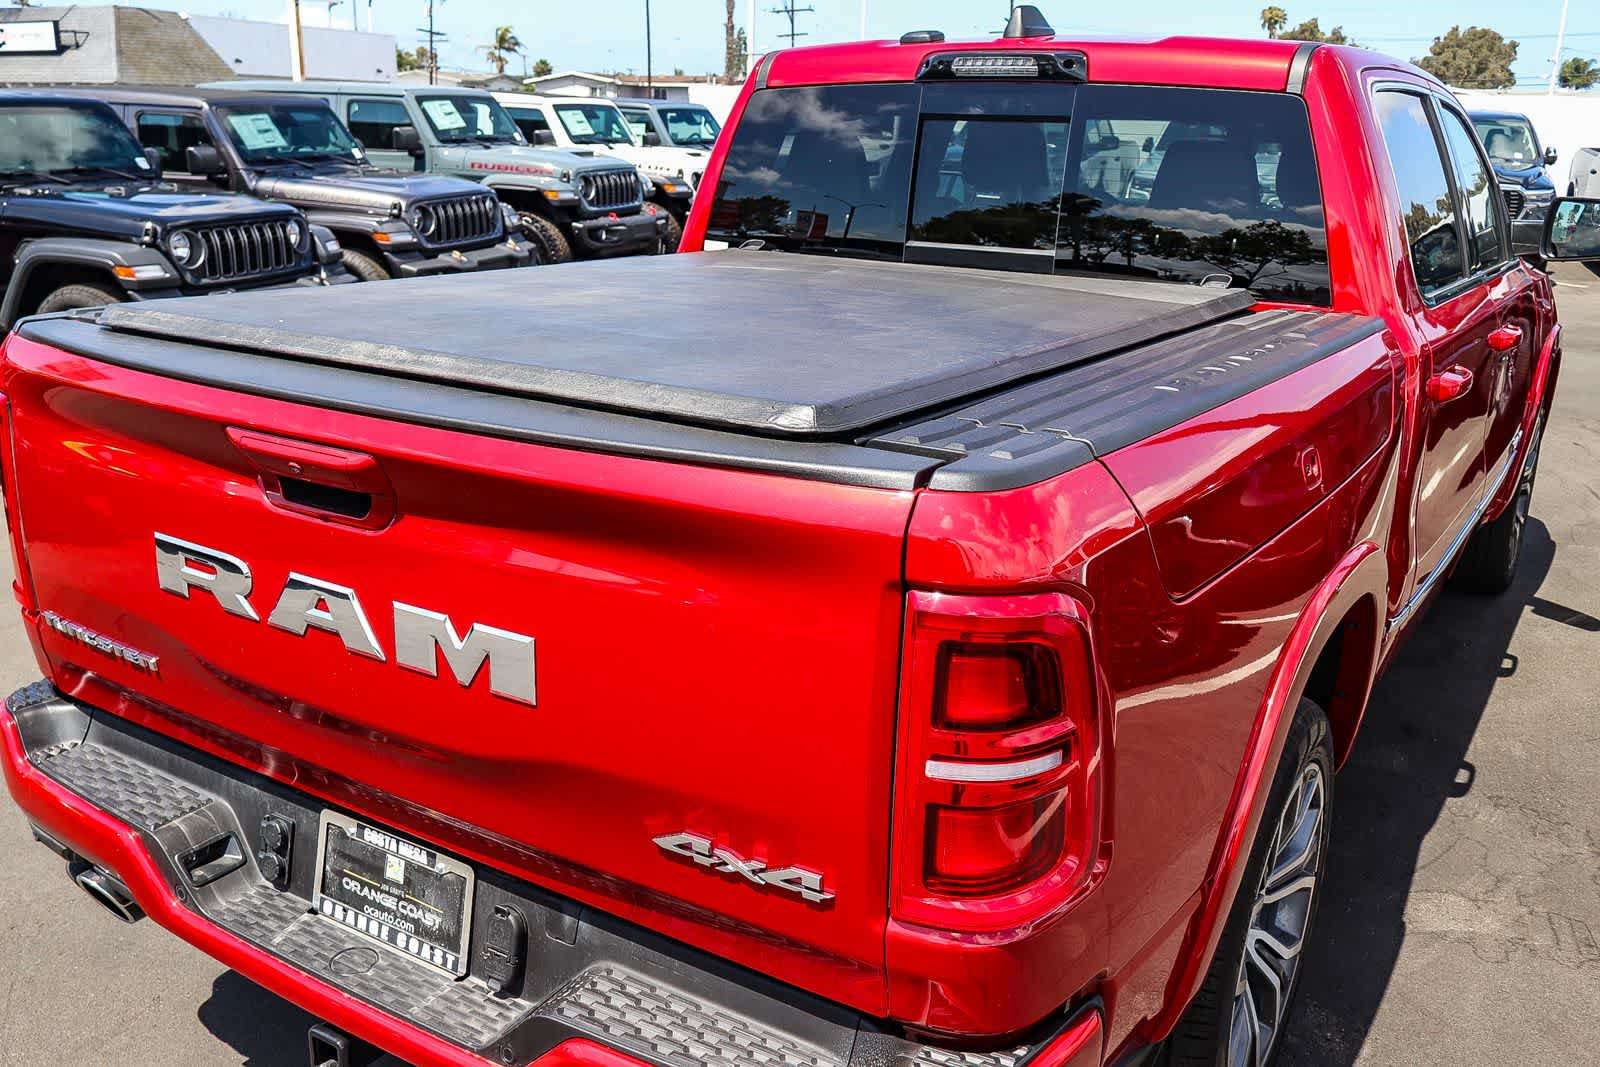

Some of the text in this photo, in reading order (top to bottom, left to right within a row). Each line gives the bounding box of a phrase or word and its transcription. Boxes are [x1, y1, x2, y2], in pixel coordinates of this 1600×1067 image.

[470, 161, 553, 175] RUBICON
[154, 530, 537, 706] RAM
[363, 828, 428, 865] COSTA MESA
[342, 877, 442, 931] ORANGE COAST
[364, 905, 415, 933] ocauto.com
[323, 899, 456, 970] ORANGE COAST
